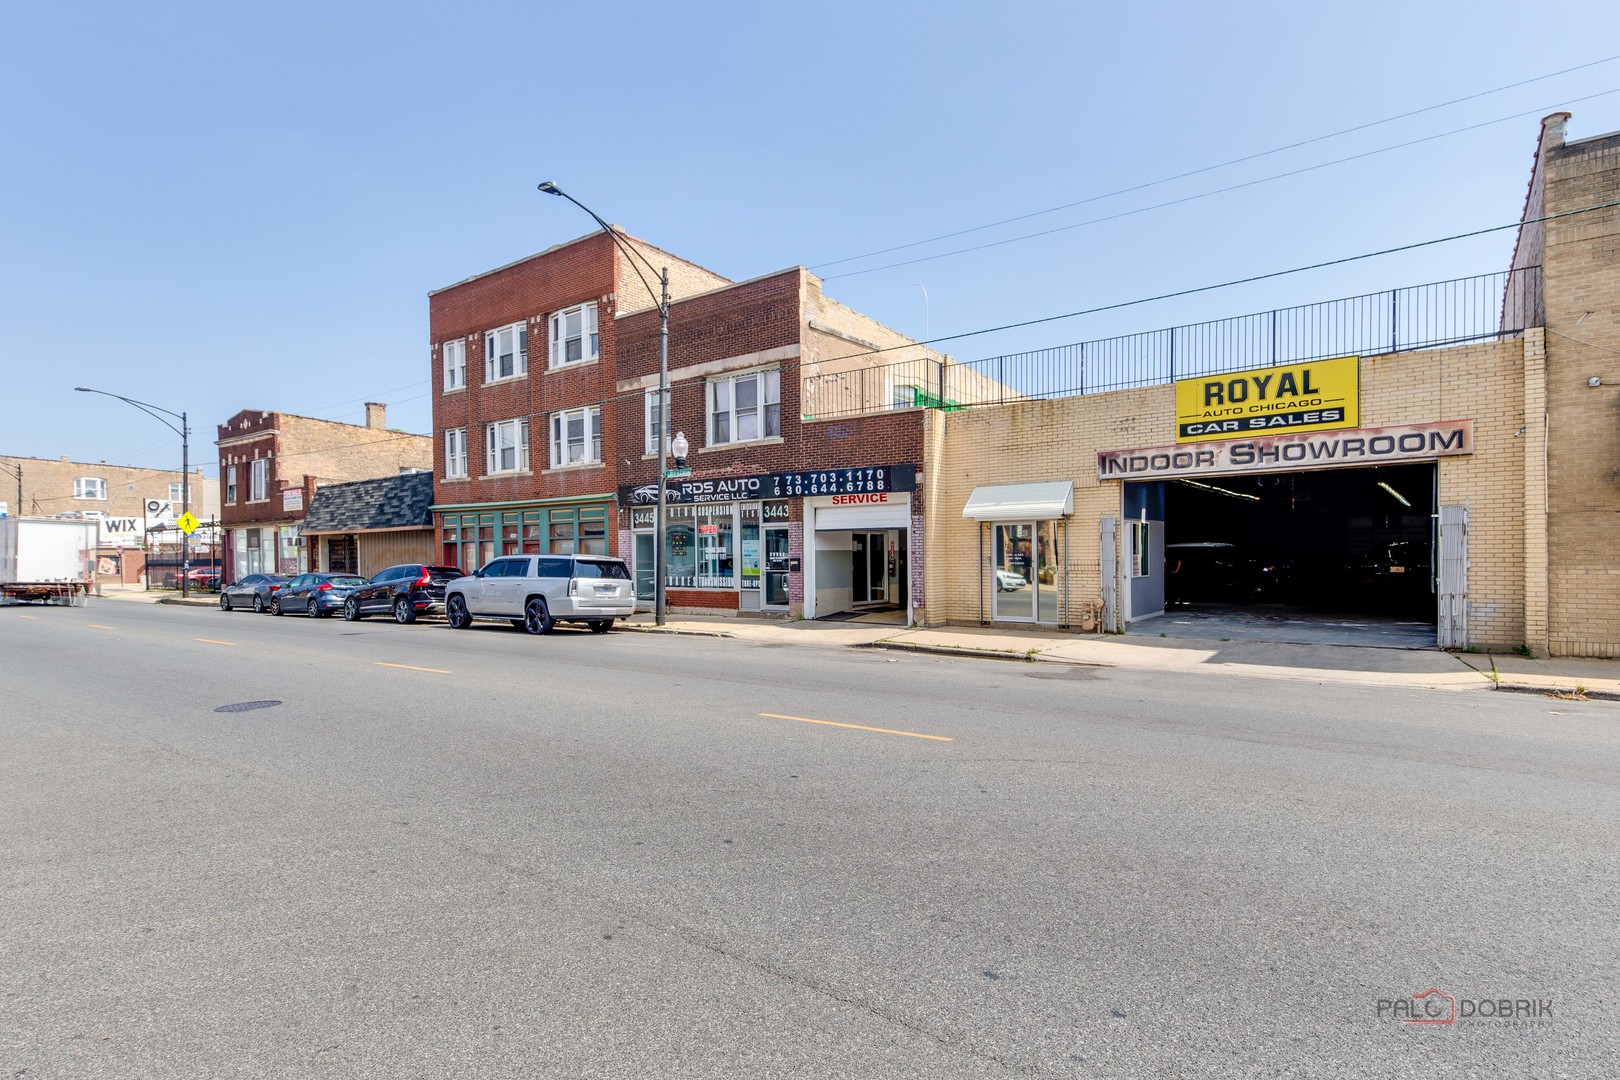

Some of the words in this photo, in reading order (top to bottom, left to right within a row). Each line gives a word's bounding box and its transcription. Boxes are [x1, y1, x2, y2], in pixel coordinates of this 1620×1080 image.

[1204, 370, 1319, 407] ROYAL
[1202, 407, 1243, 418] AUTO
[1249, 398, 1322, 413] CHICAGO
[1187, 421, 1239, 435] CAR
[1249, 409, 1340, 428] SALES
[1100, 449, 1217, 475] INDOOR
[1229, 429, 1464, 466] SHOWROOM
[682, 482, 713, 495] RDS
[717, 478, 760, 492] AUTO
[693, 493, 730, 502] SERVICE
[731, 491, 748, 500] LLC
[832, 493, 888, 505] SERVICE
[634, 511, 655, 524] 3445
[698, 505, 733, 517] SUSPENSION
[764, 505, 789, 518] 3443
[105, 519, 137, 533] WIX
